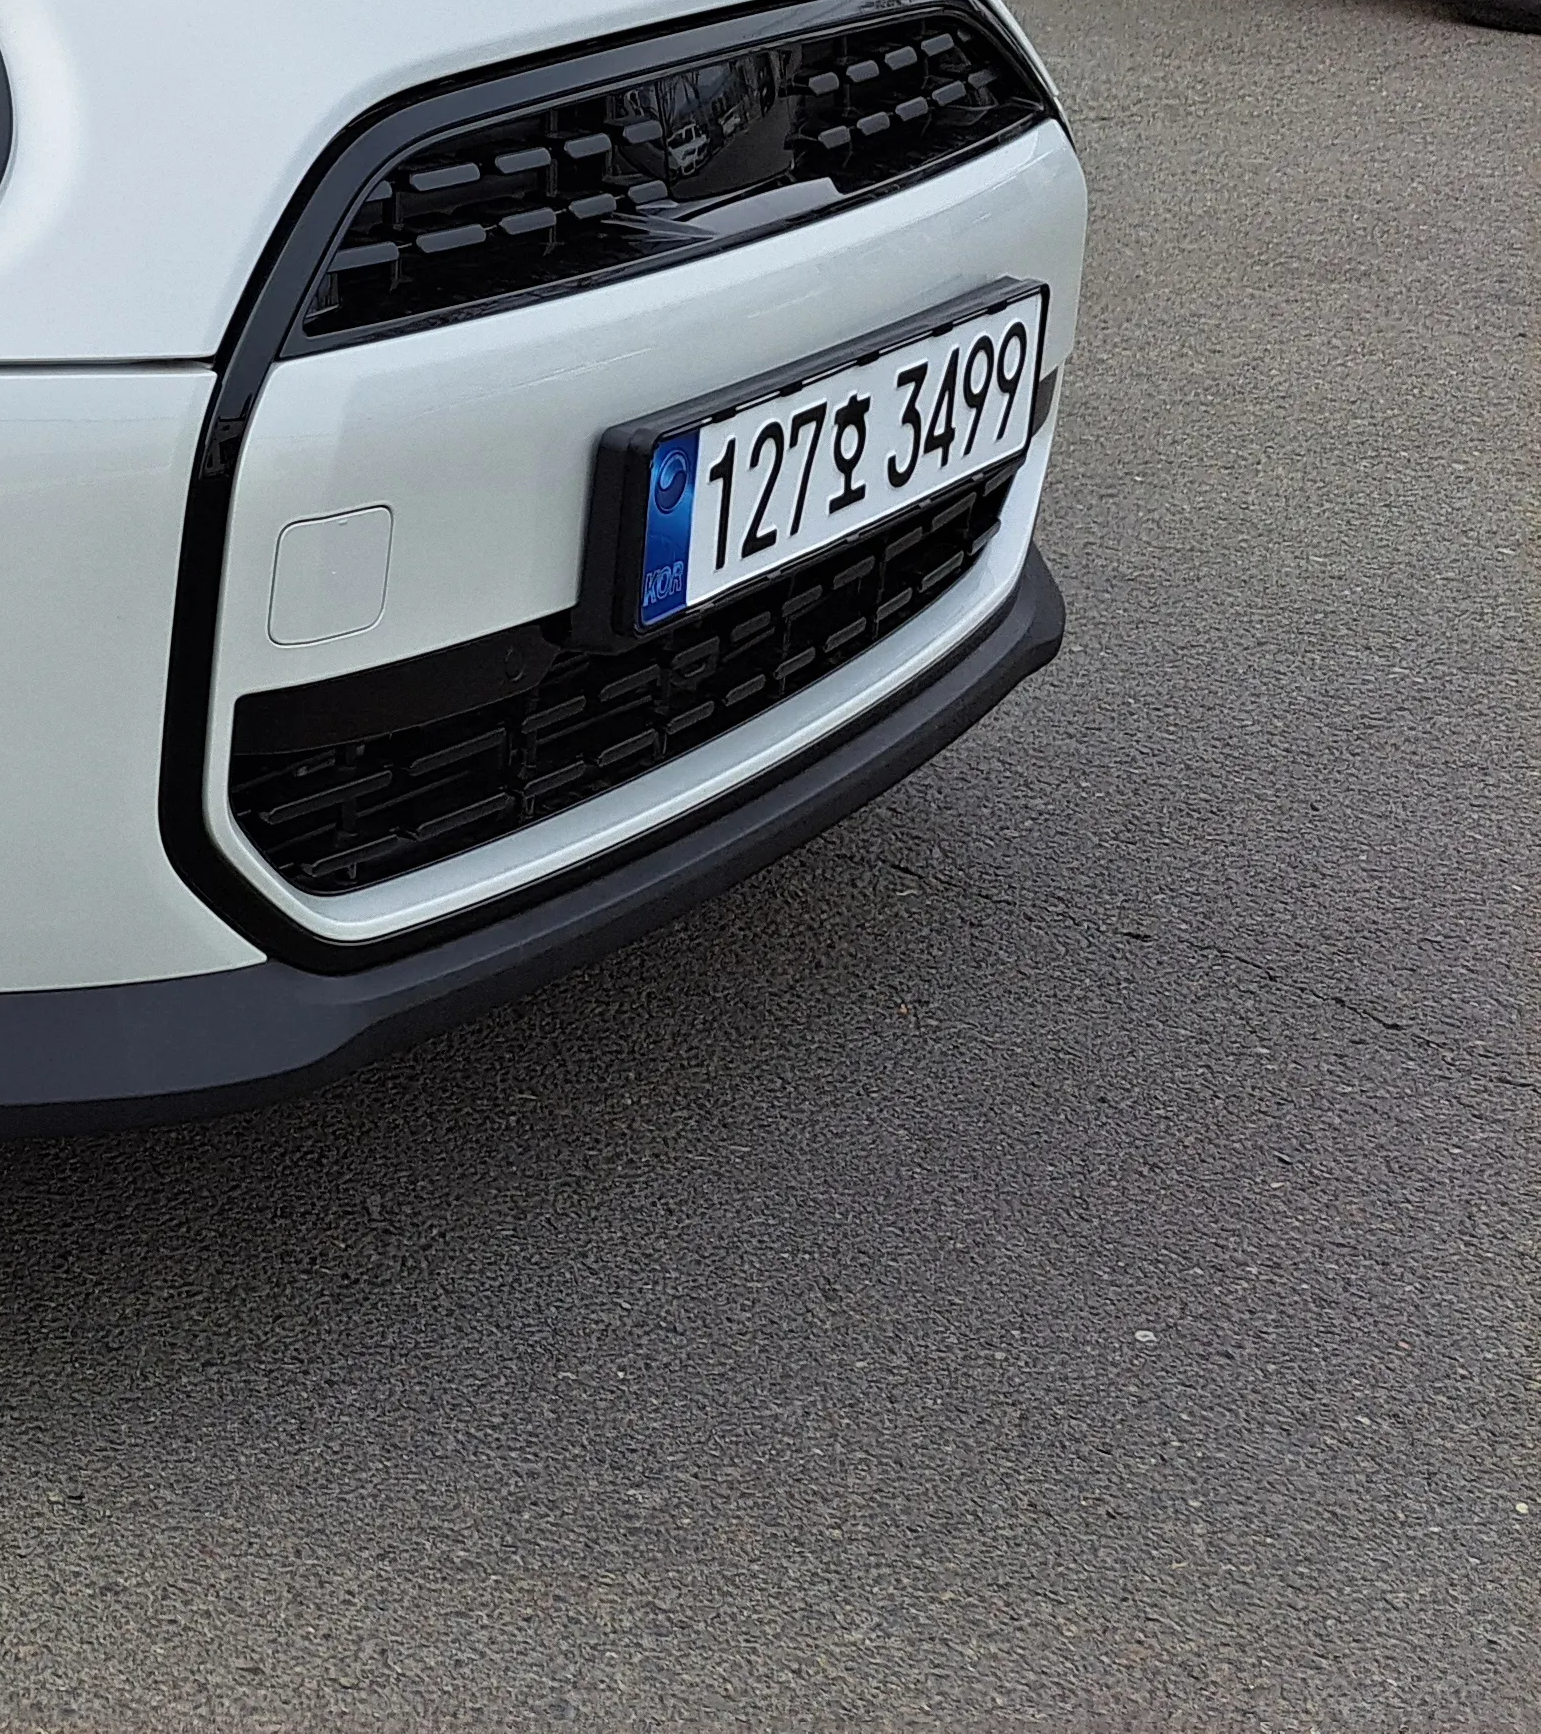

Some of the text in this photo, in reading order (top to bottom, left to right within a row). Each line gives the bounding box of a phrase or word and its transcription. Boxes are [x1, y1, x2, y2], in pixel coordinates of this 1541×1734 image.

[705, 321, 1027, 573] 127호 3499
[641, 559, 685, 607] KOR
